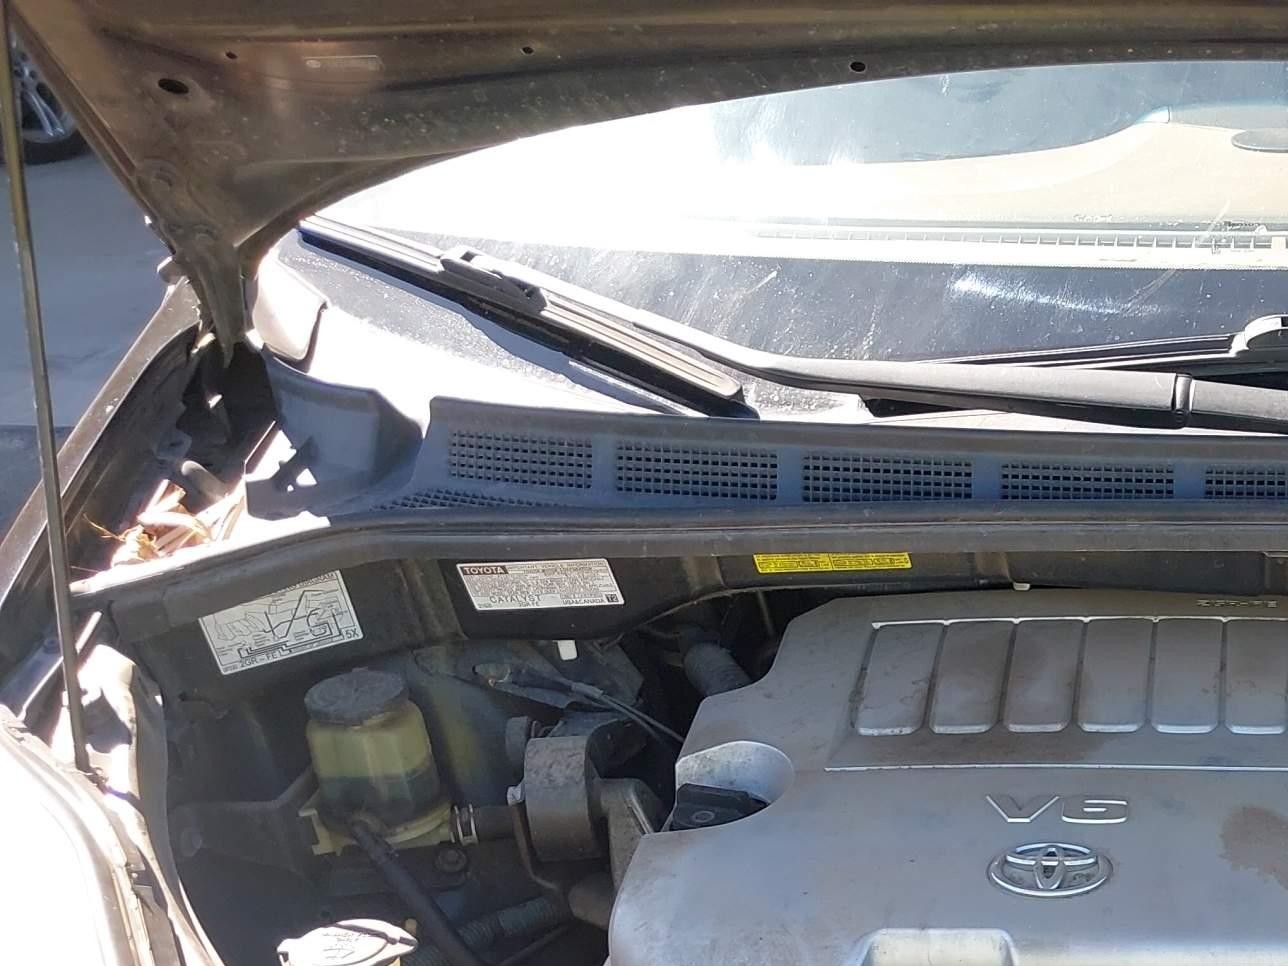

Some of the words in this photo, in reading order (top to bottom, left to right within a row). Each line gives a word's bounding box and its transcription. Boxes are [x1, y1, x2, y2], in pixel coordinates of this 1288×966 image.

[464, 566, 505, 575] TOYOTA
[490, 594, 542, 603] CATALYST
[985, 794, 1129, 825] V6
